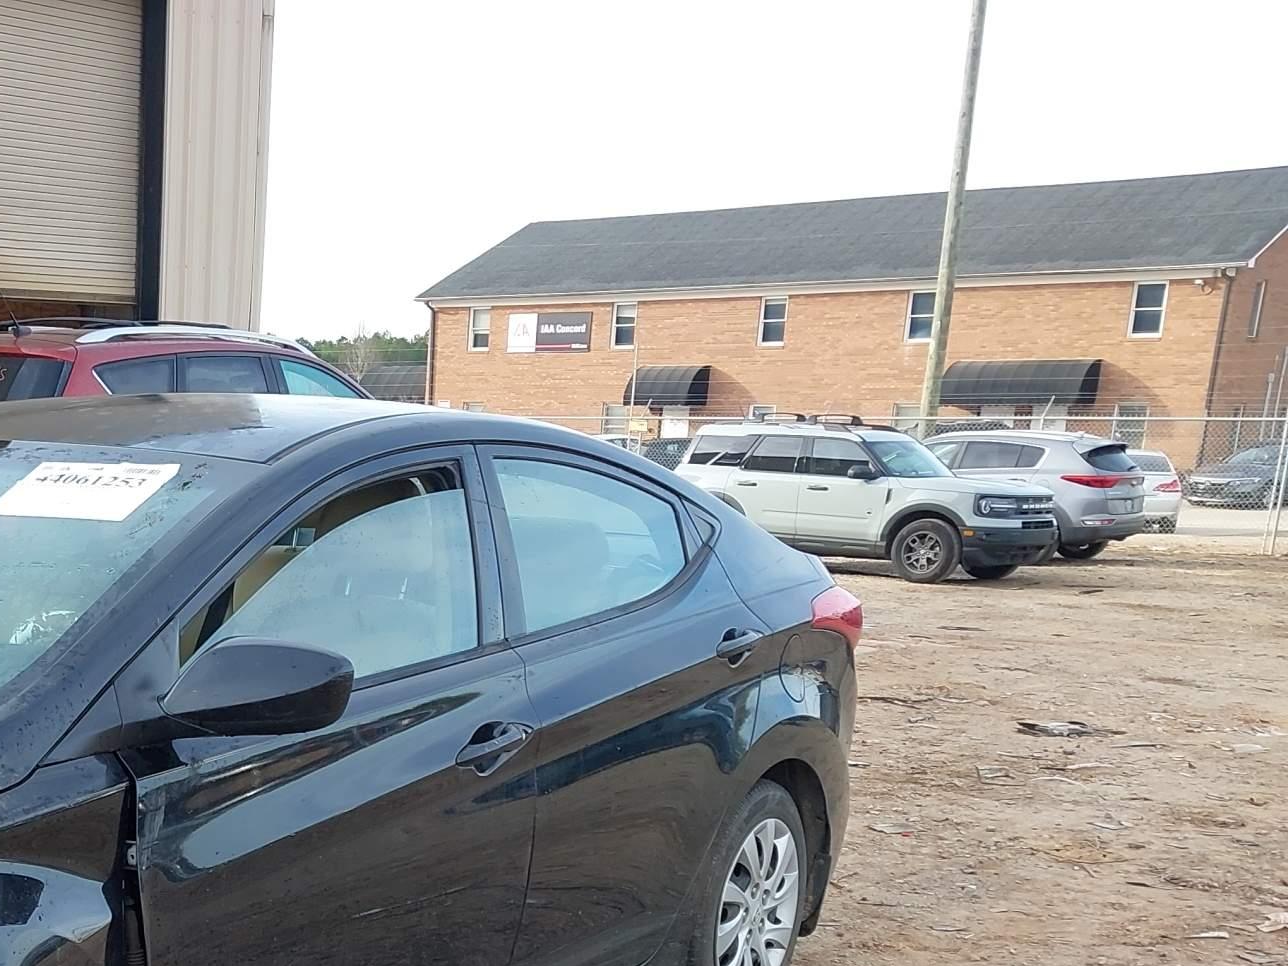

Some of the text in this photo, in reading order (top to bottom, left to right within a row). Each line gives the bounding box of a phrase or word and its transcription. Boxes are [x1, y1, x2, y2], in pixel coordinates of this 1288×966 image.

[540, 324, 555, 334] IAA
[556, 323, 587, 333] Concord
[35, 474, 147, 488] 44061253
